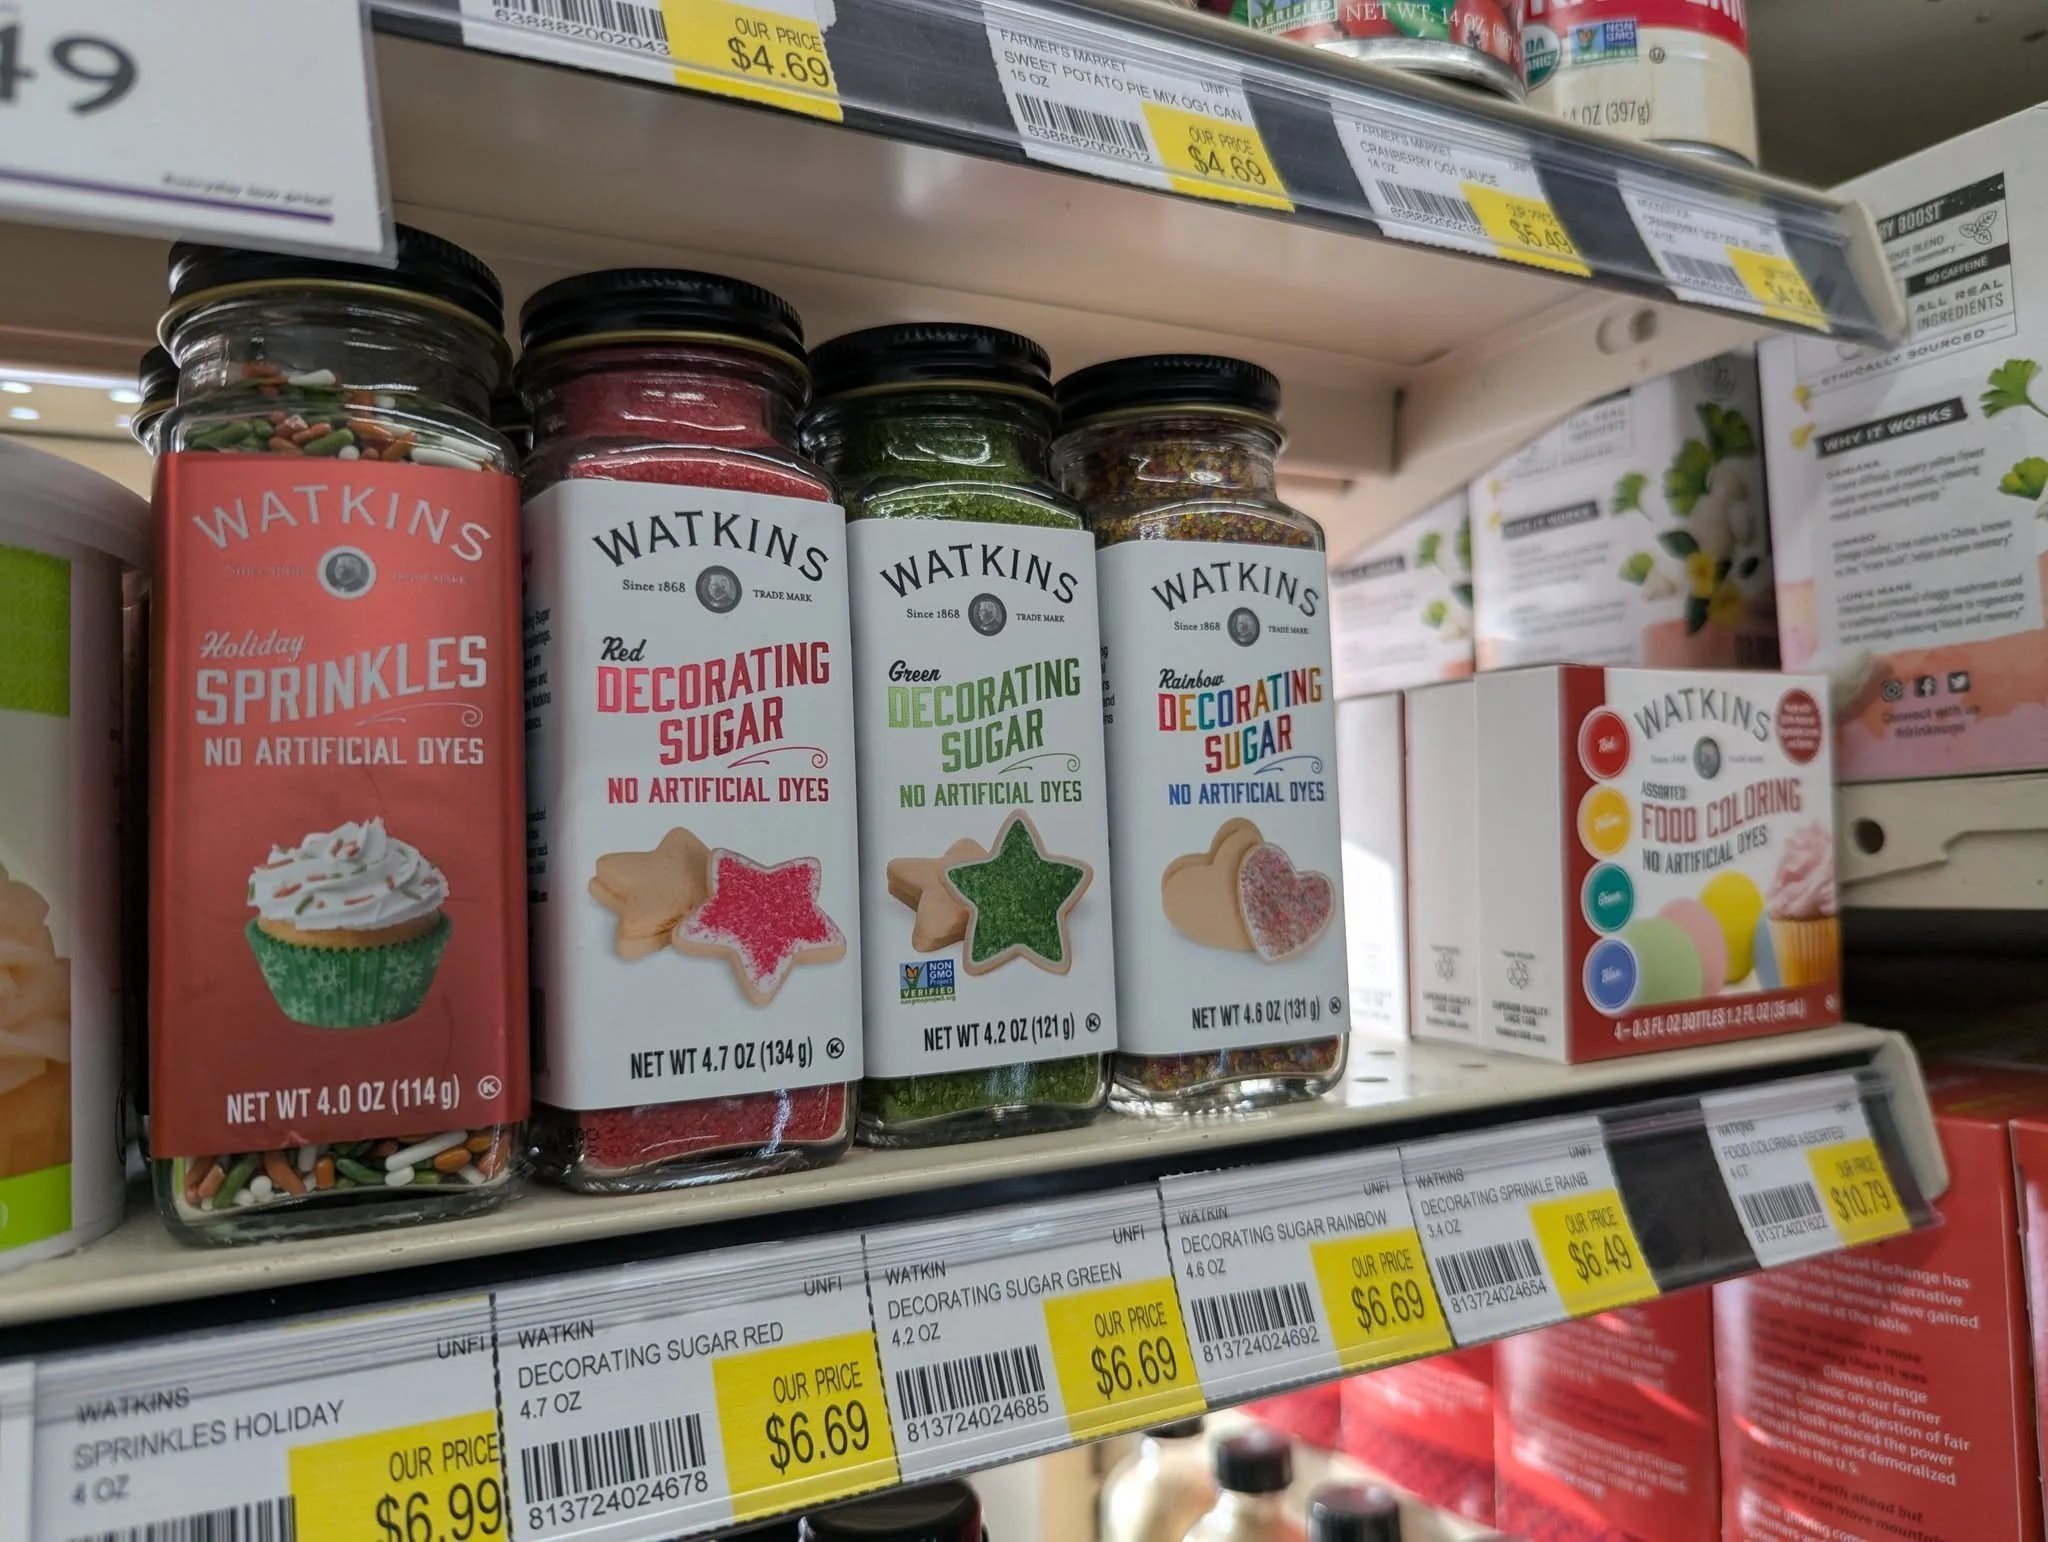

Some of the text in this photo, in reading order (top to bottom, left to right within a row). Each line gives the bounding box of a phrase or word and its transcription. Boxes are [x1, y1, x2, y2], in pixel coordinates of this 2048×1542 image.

[1346, 3, 1391, 22] NET
[735, 17, 824, 53] OUR PRICE
[1000, 29, 1128, 73] FARMER'S MARKET
[728, 37, 830, 88] $4.69
[1004, 51, 1243, 122] SWEET POTATO PIE CAN
[1030, 74, 1051, 89] OZ
[1189, 126, 1215, 148] OUR
[1187, 144, 1267, 186] $4.69
[1360, 140, 1431, 170] CRANBERRY
[1897, 202, 1943, 235] BOOST
[1509, 217, 1574, 256] $5.49
[1940, 255, 1989, 280] CAFFEINE
[1915, 279, 2004, 314] ALL REAL
[1916, 292, 2005, 332] INGREDIENTS
[1821, 328, 1985, 386] ETHICALLY SOURCED
[1824, 406, 1953, 451] WHY IT WORKS
[192, 484, 492, 562] WATKINS
[592, 510, 830, 582] WATKINS
[622, 579, 686, 593] Since 1868
[879, 543, 1078, 604] WATKINS
[1151, 561, 1319, 618] WATKINS
[753, 589, 813, 602] TRADE MARK
[906, 608, 960, 619] Since 1868
[1016, 613, 1042, 622] TRADE
[1174, 621, 1198, 631] Since
[200, 629, 306, 662] Holiday
[600, 636, 647, 662] Red
[196, 635, 488, 726] SPRINKLES
[596, 641, 830, 714] DECORATING
[888, 660, 941, 682] Green
[1158, 668, 1224, 690] Rainbow
[887, 657, 1081, 728] DECORATING
[1158, 667, 1323, 731] DECORATING
[659, 696, 784, 766] SUGAR
[1634, 688, 1771, 743] WATKINS
[204, 737, 485, 767] NO ARTIFICIAL DYES
[941, 708, 1044, 773] SUGAR
[1204, 714, 1293, 774] SUGAR
[608, 777, 829, 804] NO ARTIFICIAL DYES
[900, 780, 1083, 808] NO ARTIFICIAL DYES
[1168, 781, 1324, 805] NO ARTIFICIAL DYES
[1641, 781, 1687, 801] ASSORTED
[1641, 778, 1803, 844] FOOD COLORING
[1642, 825, 1768, 874] NO ARTIFICIAL DYES
[929, 961, 952, 971] NON
[929, 970, 953, 980] GMO
[929, 977, 953, 987] Project
[900, 994, 956, 1005] nongmoproject.org
[903, 986, 953, 998] VERIFIED
[1191, 1000, 1281, 1030] NET WT 4.6 OZ
[1682, 1009, 1724, 1031] BOTTLES
[924, 1018, 1028, 1051] NET WT 4.2 OZ
[630, 1041, 756, 1080] NET WT 4.7 OZ
[226, 1081, 386, 1125] NET WT 4.0 OZ
[1752, 1125, 1845, 1156] COLORING ASSORTED
[1415, 1167, 1464, 1189] WATKINS
[1420, 1171, 1589, 1217] DECORATING SPRINKLE RAINB
[1831, 1179, 1891, 1225] $10.79
[1112, 1223, 1145, 1244] UNFI
[1181, 1209, 1387, 1255] DECORATING SUGAR RAINBOW
[1444, 1219, 1462, 1235] OZ
[1565, 1206, 1618, 1235] OUR PRICE
[885, 1260, 946, 1287] WATKIN
[1186, 1258, 1226, 1279] 4.6 OZ
[1352, 1248, 1413, 1280] OUR PRICE
[1568, 1233, 1632, 1286] $6.49
[1872, 1258, 1971, 1289] Exchange has
[803, 1272, 842, 1297] UNFI
[888, 1261, 1122, 1320] DECORATING SUGAR GREEN
[1094, 1301, 1167, 1338] OUR PRICE
[1351, 1278, 1425, 1337] $6.69
[1926, 1307, 1979, 1330] gained
[436, 1335, 485, 1360] UNFI
[518, 1319, 595, 1350] WATKIN
[891, 1322, 941, 1348] 4.2 OZ
[1202, 1325, 1319, 1363] 813724024692
[518, 1321, 784, 1390] DECORATING SUGAR RED
[1090, 1335, 1178, 1400] $6.69
[773, 1360, 863, 1405] OUR PRICE
[1823, 1364, 1929, 1404] Climate change
[75, 1386, 190, 1425] WATKINS
[520, 1391, 582, 1420] 4.7 OZ
[907, 1394, 1049, 1444] 813724024685
[1893, 1401, 1942, 1426] farmer
[72, 1400, 345, 1472] SPRINKLES HOLIDAY
[765, 1399, 870, 1476] $6.69
[1858, 1411, 1971, 1452] digestion fair
[388, 1431, 500, 1483] OUR PRICE
[1867, 1450, 1957, 1488] demoralized
[1910, 1445, 1955, 1467] power
[92, 1474, 131, 1501] OZ
[528, 1470, 709, 1532] 813724024678
[375, 1476, 502, 1542] $6.99
